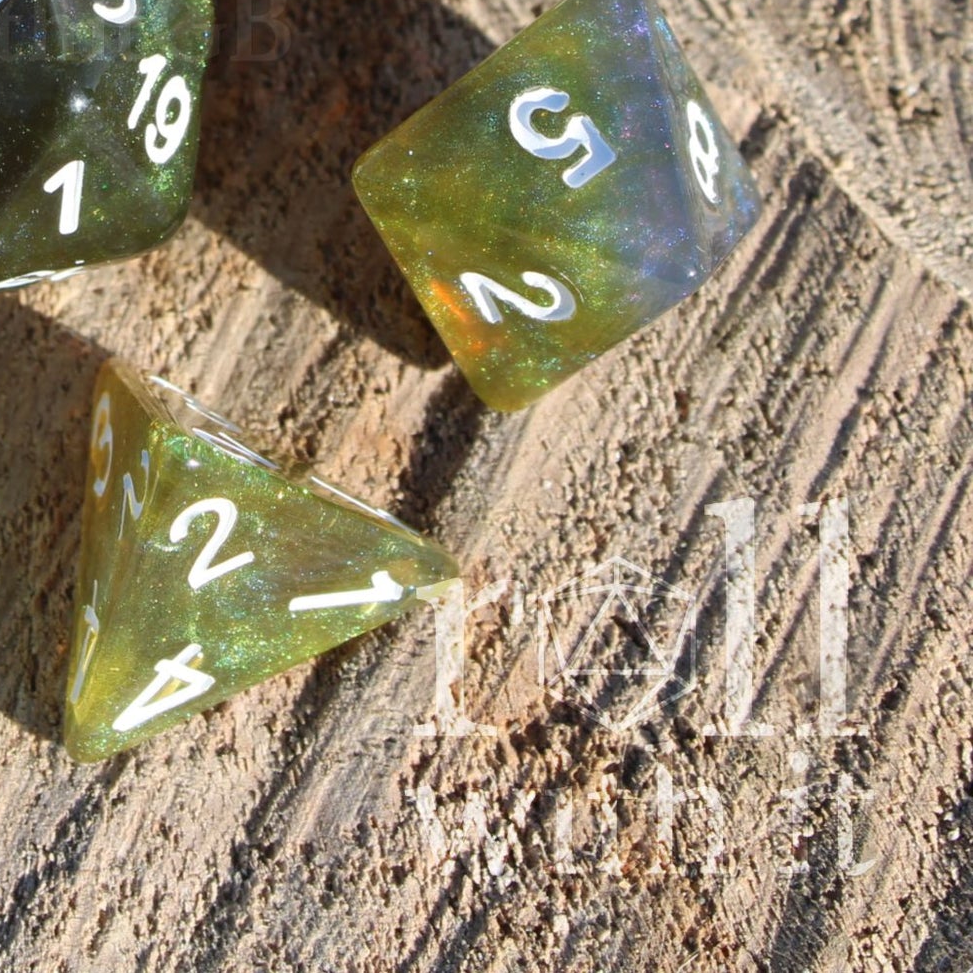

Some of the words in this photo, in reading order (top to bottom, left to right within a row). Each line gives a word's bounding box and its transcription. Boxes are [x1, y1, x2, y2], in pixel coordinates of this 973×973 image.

[126, 54, 192, 164] 19
[509, 86, 618, 189] 5
[43, 160, 85, 235] 1
[459, 271, 576, 323] 2
[169, 497, 255, 590] 2
[289, 570, 404, 612] 1
[112, 643, 216, 732] 4
